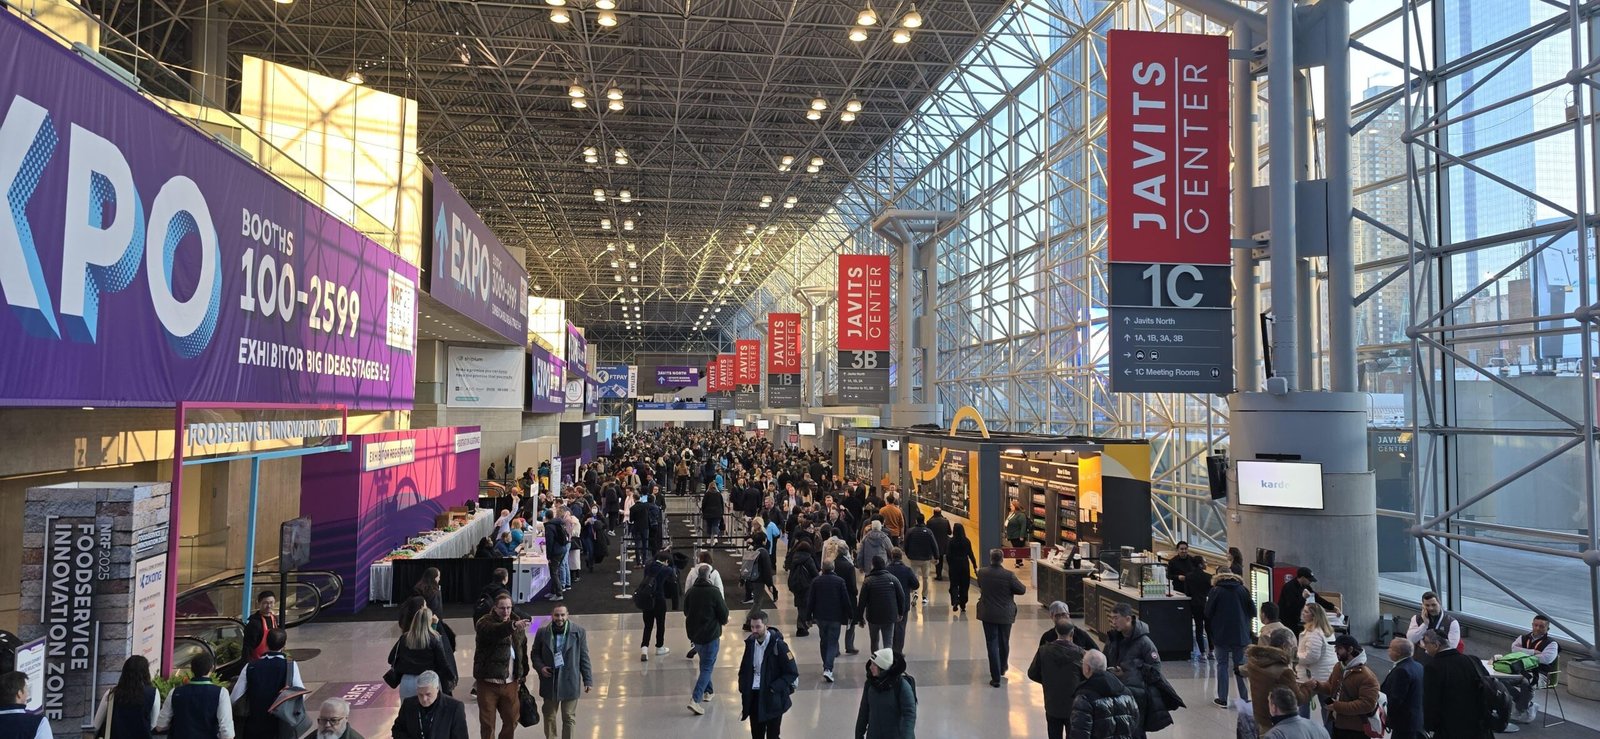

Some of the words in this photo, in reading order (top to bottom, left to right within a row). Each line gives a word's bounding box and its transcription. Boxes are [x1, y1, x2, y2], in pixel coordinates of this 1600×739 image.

[1132, 61, 1166, 231] JAVITS
[1183, 64, 1209, 234] CENTER
[242, 208, 293, 256] BOOTHS
[451, 212, 490, 301] EXPO
[240, 248, 360, 338] 100-2599
[847, 267, 863, 337] JAVITS
[869, 267, 882, 338] CENTER
[1142, 264, 1204, 308] 1C
[238, 337, 303, 370] EXHIBITOR
[306, 350, 322, 374] BIG
[324, 353, 351, 377] IDEAS
[351, 356, 379, 381] STAGES
[380, 364, 390, 381] 1-2
[774, 320, 784, 365] JAVITS
[788, 320, 796, 366] CENTER
[851, 351, 878, 369] 3B
[1135, 334, 1146, 342] 1A,
[1147, 334, 1158, 342] 1B,
[740, 345, 748, 379] JAVITS
[777, 374, 793, 385] 1B
[1146, 369, 1174, 377] Meeting
[741, 384, 755, 393] 3A
[188, 420, 269, 446] FOODSERVICE
[270, 420, 320, 440] INNOVATION
[320, 419, 340, 437] ZON
[100, 524, 112, 549] NRF
[98, 550, 111, 580] 2025
[48, 524, 72, 656] INNOVATION
[71, 524, 94, 670] FOODSERVICE
[45, 662, 65, 720] ZONE
